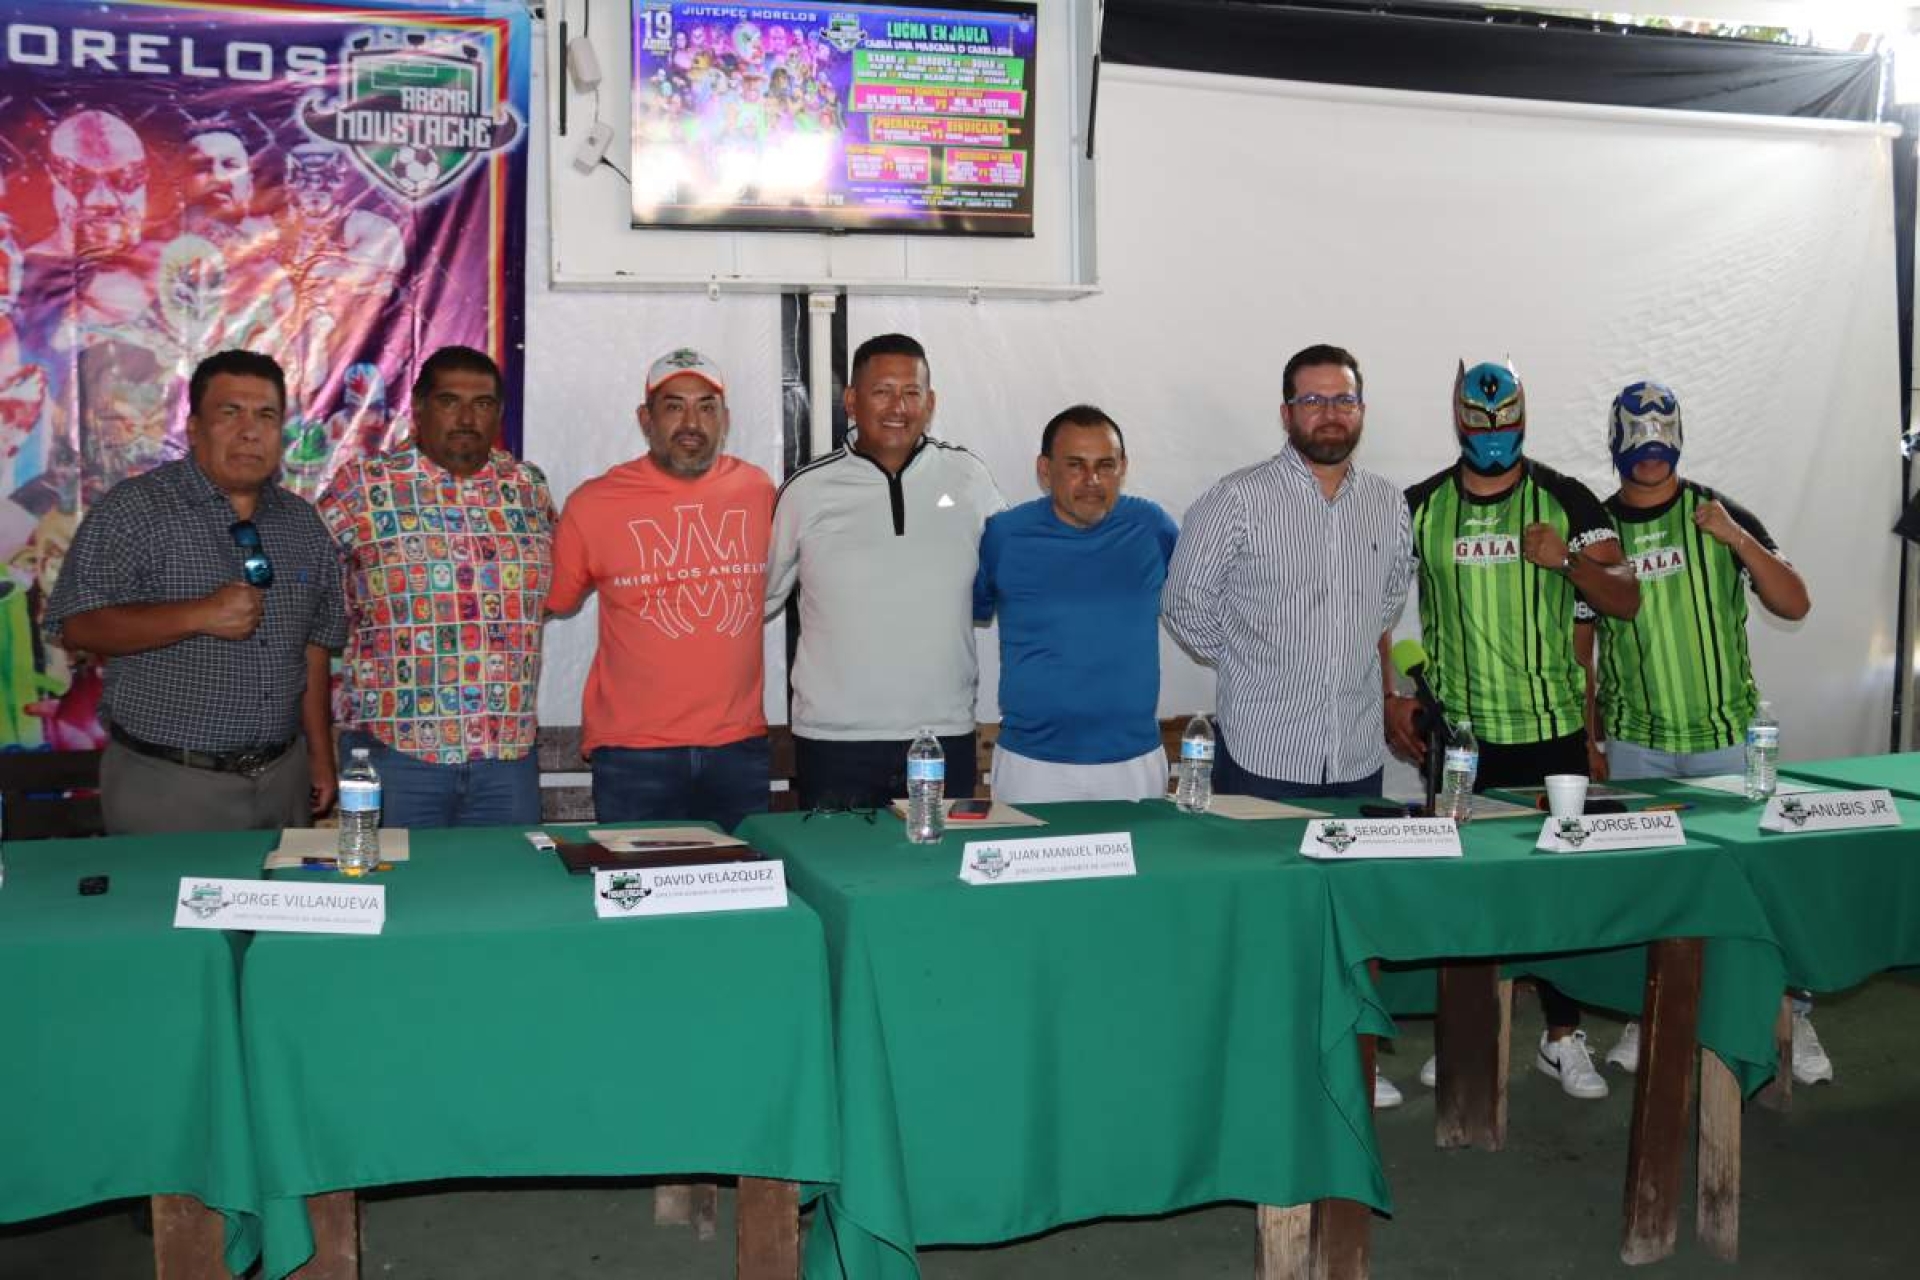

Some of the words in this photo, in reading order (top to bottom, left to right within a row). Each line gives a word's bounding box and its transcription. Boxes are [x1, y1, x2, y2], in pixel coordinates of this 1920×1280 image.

[640, 10, 673, 40] 19
[751, 12, 817, 22] MORELOS
[887, 21, 928, 40] LUCHA
[931, 25, 948, 41] EN
[949, 25, 990, 43] JAULA
[401, 86, 470, 108] ARENA
[336, 105, 494, 148] MOUSTACHE
[1456, 540, 1516, 557] GALA
[1630, 551, 1682, 573] ALA
[614, 573, 659, 586] AMIRI
[666, 567, 701, 581] LOS
[1811, 801, 1866, 818] ANUBIS
[1870, 799, 1888, 814] JR
[1354, 825, 1400, 836] SERGIO
[1404, 825, 1454, 836] PERALTA
[1590, 817, 1638, 833] JORGE
[1009, 847, 1039, 861] JUAN
[1042, 845, 1092, 858] MANUEL
[1095, 842, 1129, 855] ROJAS
[653, 873, 695, 888] DAVID
[231, 892, 279, 907] JORGE
[284, 894, 380, 910] VILLANUEVA
